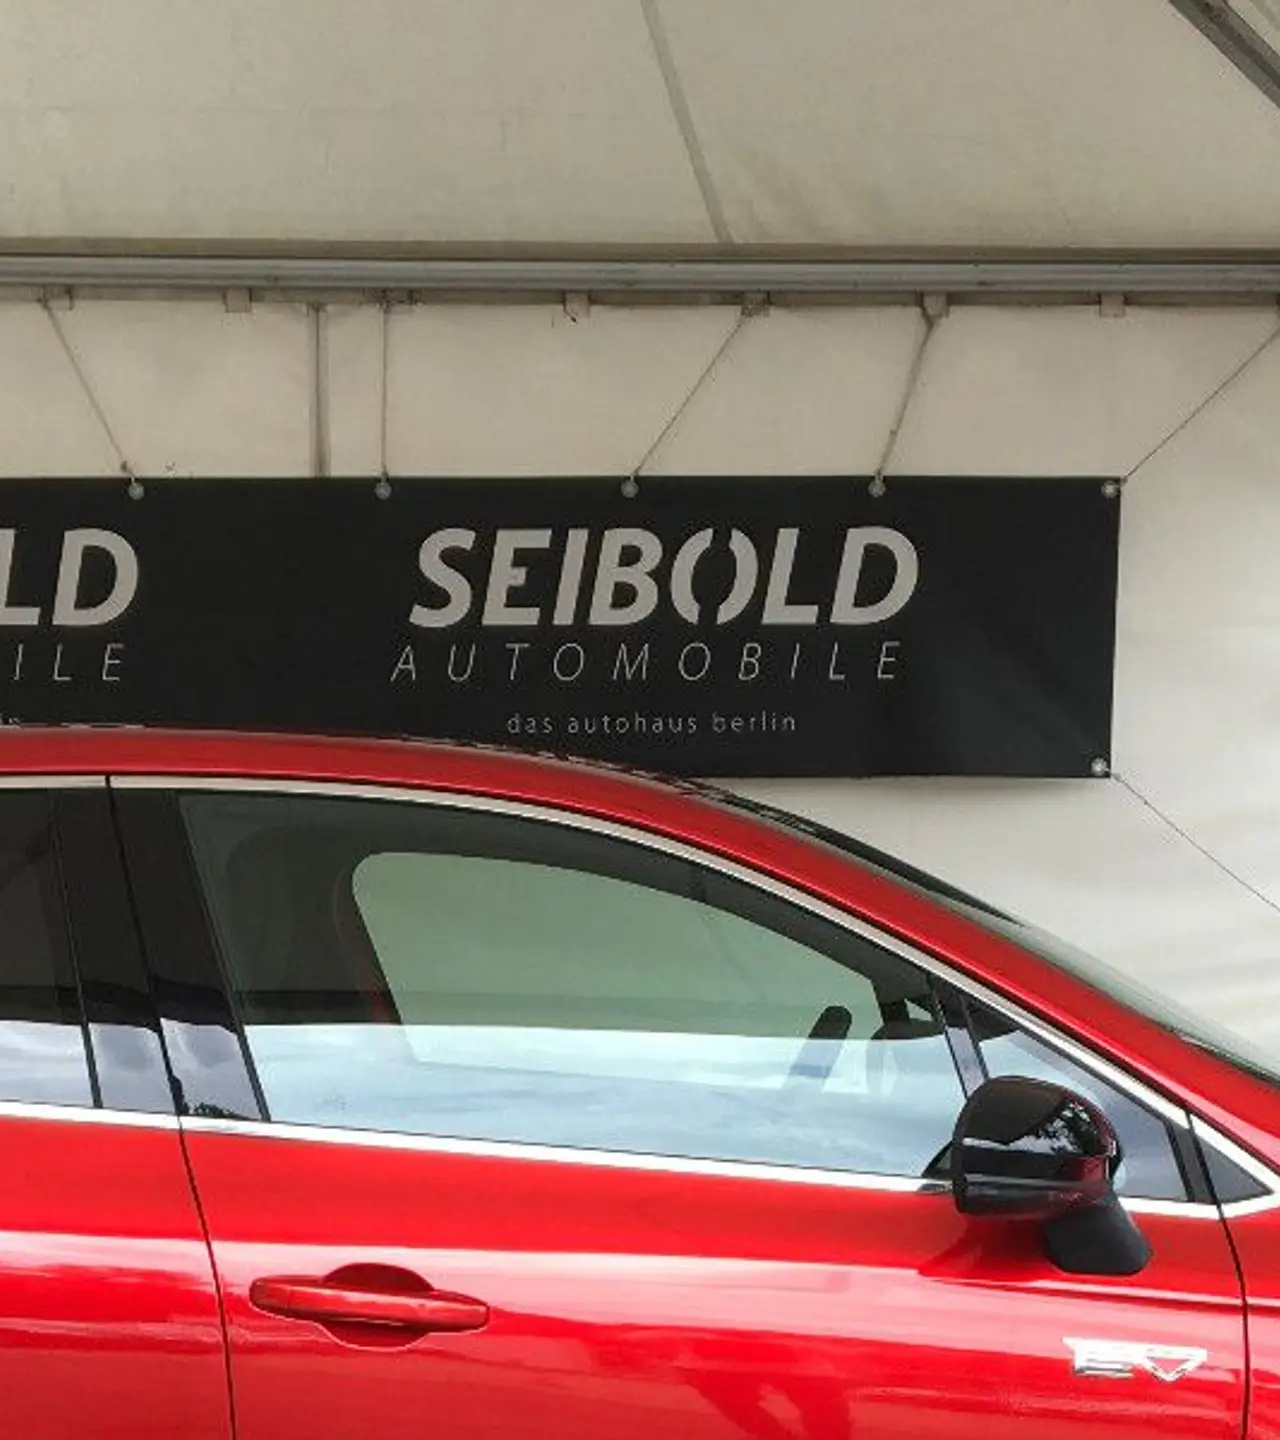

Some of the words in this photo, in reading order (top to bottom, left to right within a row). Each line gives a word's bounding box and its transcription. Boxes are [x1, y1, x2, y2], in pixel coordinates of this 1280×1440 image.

[409, 526, 919, 628] SEIBOLD
[391, 641, 902, 682] AUTOMOBILE
[507, 711, 553, 734] das
[567, 711, 698, 734] autohaus
[712, 710, 796, 733] berlin
